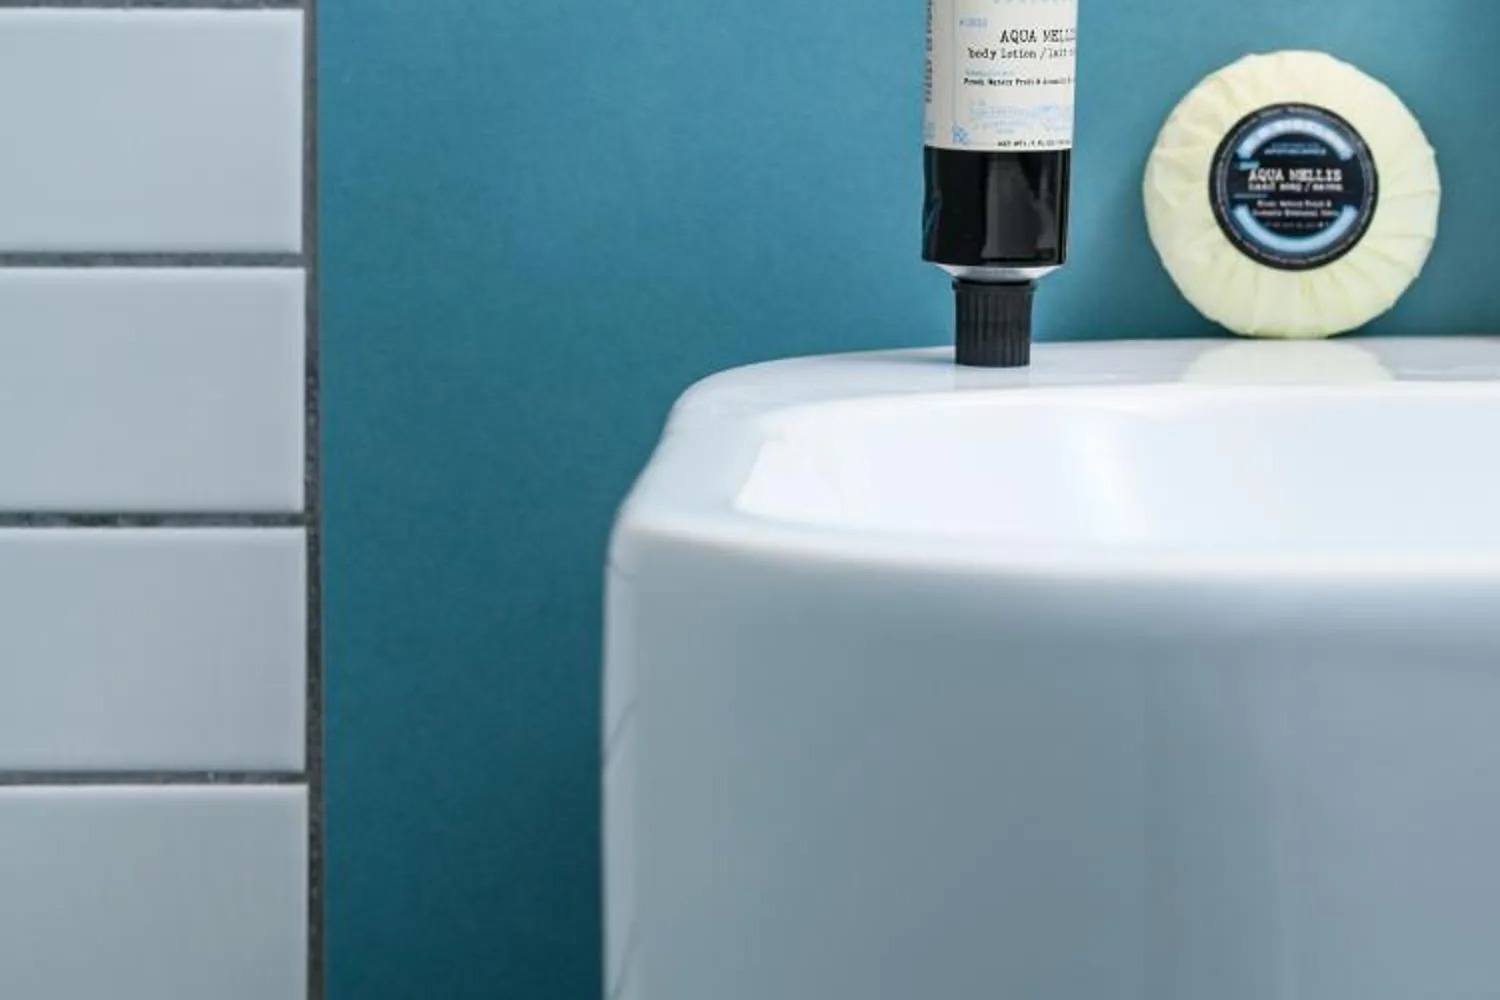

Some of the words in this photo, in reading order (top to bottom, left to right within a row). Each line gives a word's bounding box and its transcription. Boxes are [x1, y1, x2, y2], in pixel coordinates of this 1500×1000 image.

[1000, 29, 1037, 44] AQUA
[1043, 29, 1076, 44] MELLI
[967, 47, 997, 61] body
[1001, 47, 1037, 58] lotion
[1248, 168, 1285, 182] AQUA
[1289, 168, 1343, 182] MELLIS
